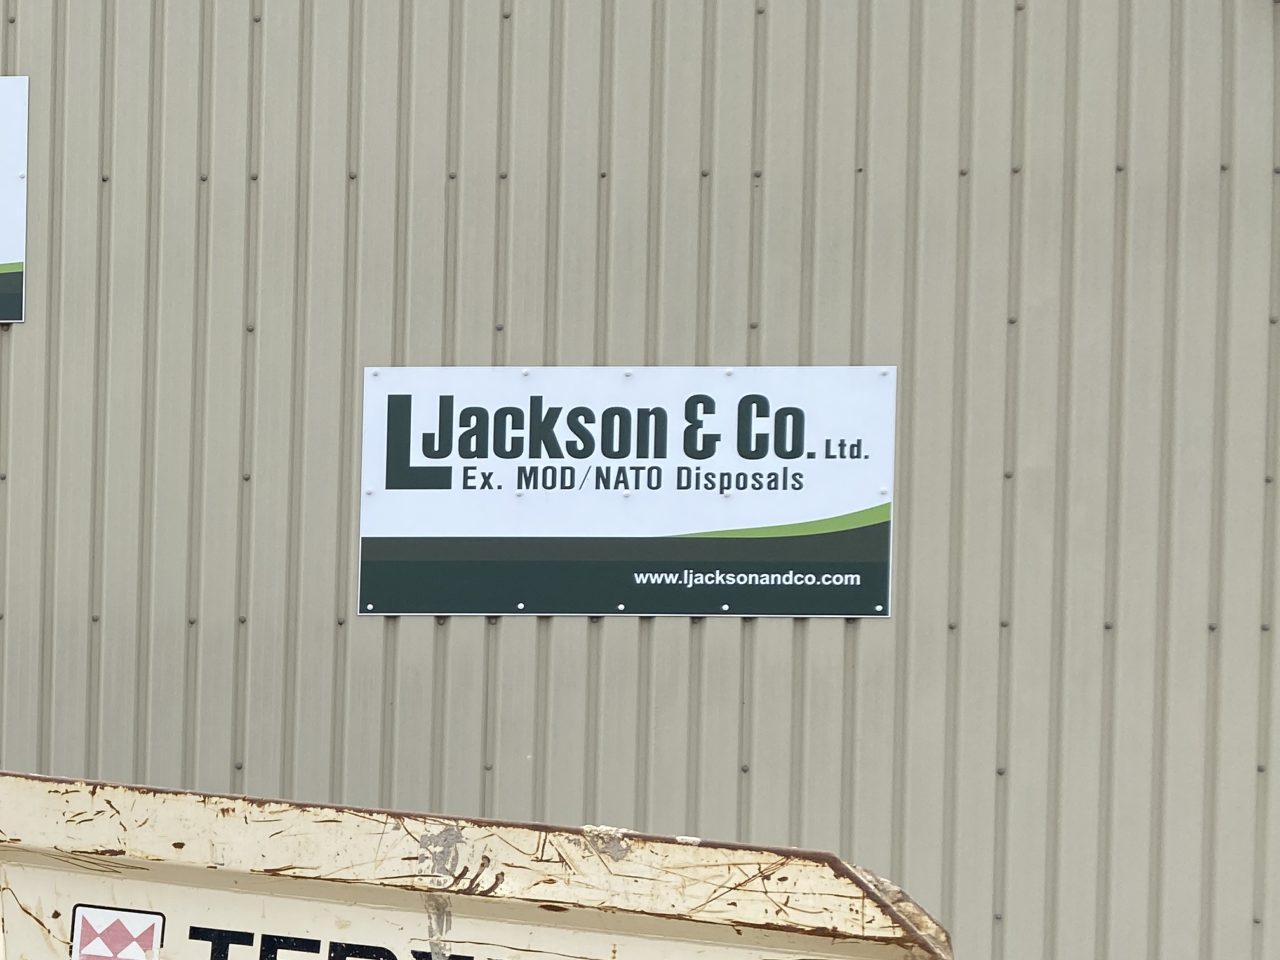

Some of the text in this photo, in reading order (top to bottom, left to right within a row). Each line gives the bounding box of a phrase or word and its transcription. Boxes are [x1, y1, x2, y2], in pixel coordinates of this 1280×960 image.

[682, 393, 722, 461] &
[736, 393, 817, 461] Co.
[824, 438, 870, 461] Ltd.
[462, 464, 805, 495] Ex. MOD/NATO Disposals
[633, 569, 861, 589] www.ljacksonandco.com
